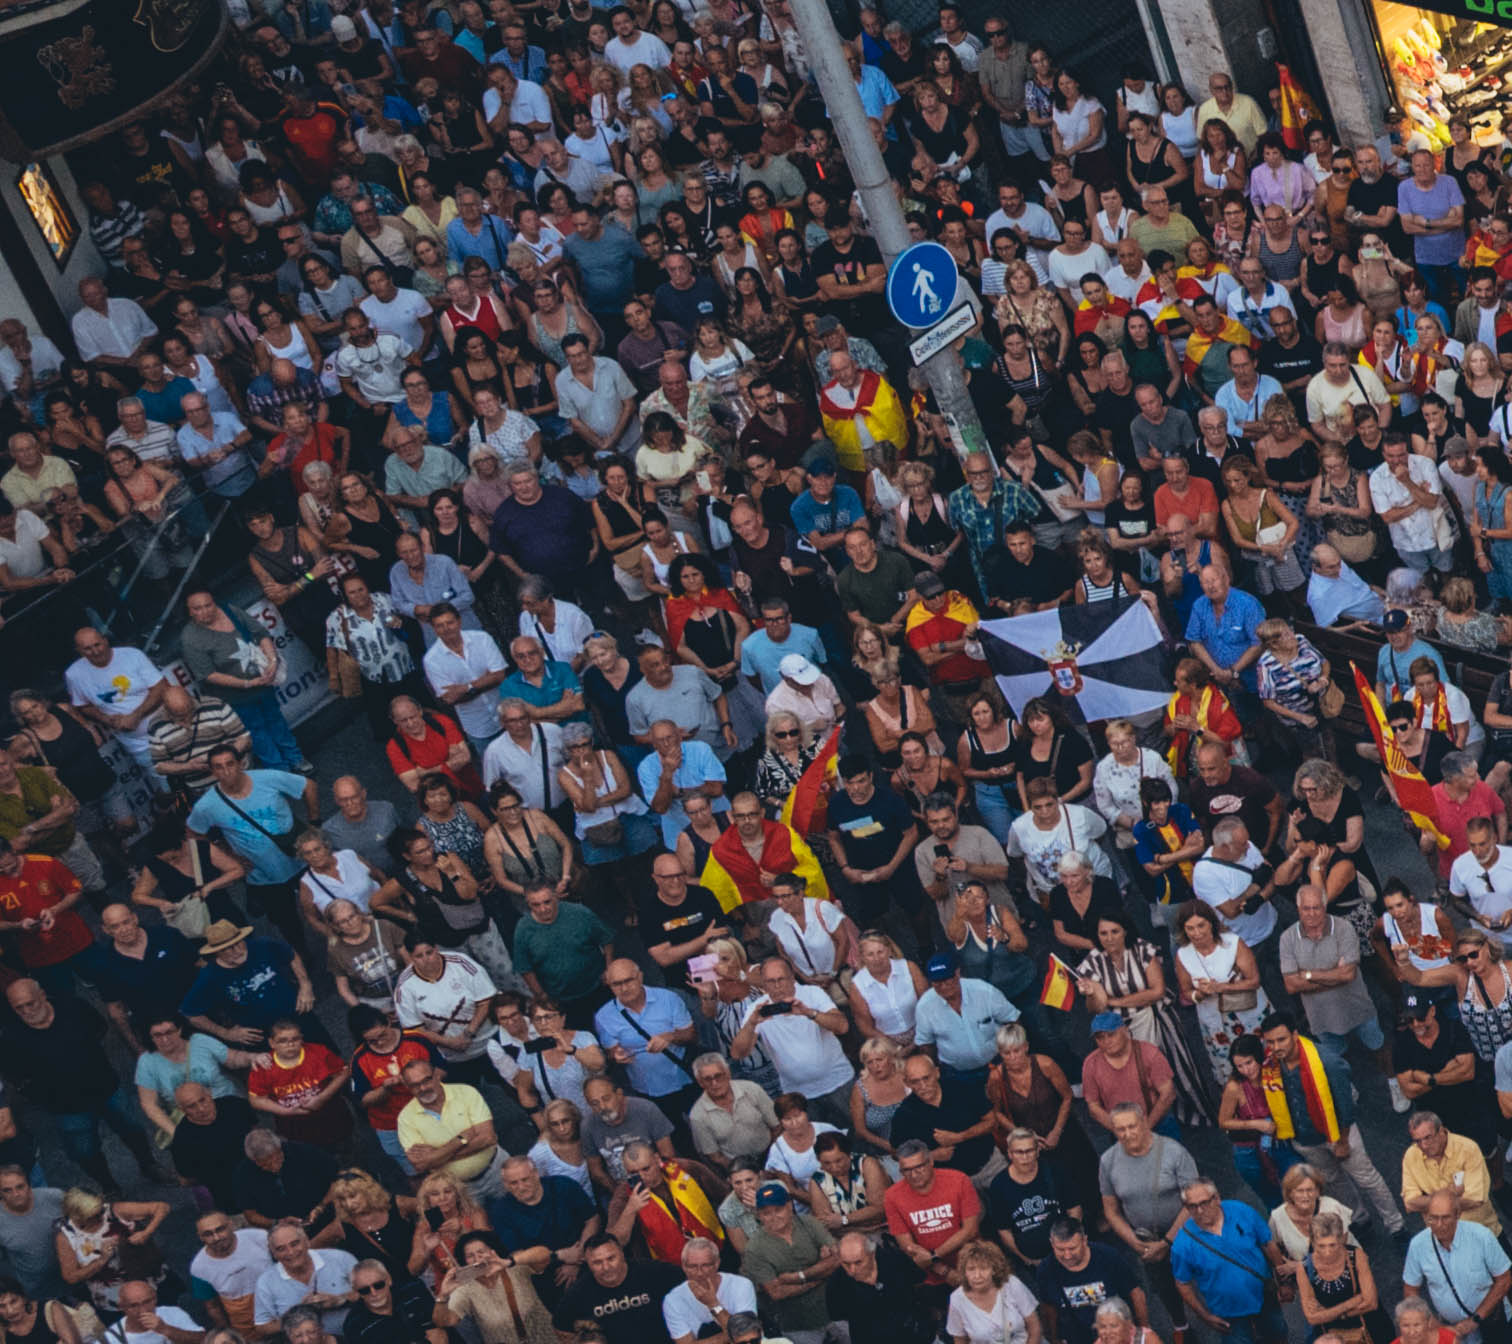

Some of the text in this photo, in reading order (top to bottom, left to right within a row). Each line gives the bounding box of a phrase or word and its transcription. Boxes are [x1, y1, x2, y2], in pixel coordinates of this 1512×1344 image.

[2, 892, 20, 910] 21
[909, 1203, 954, 1226] VENICE
[593, 1292, 650, 1318] adidas
